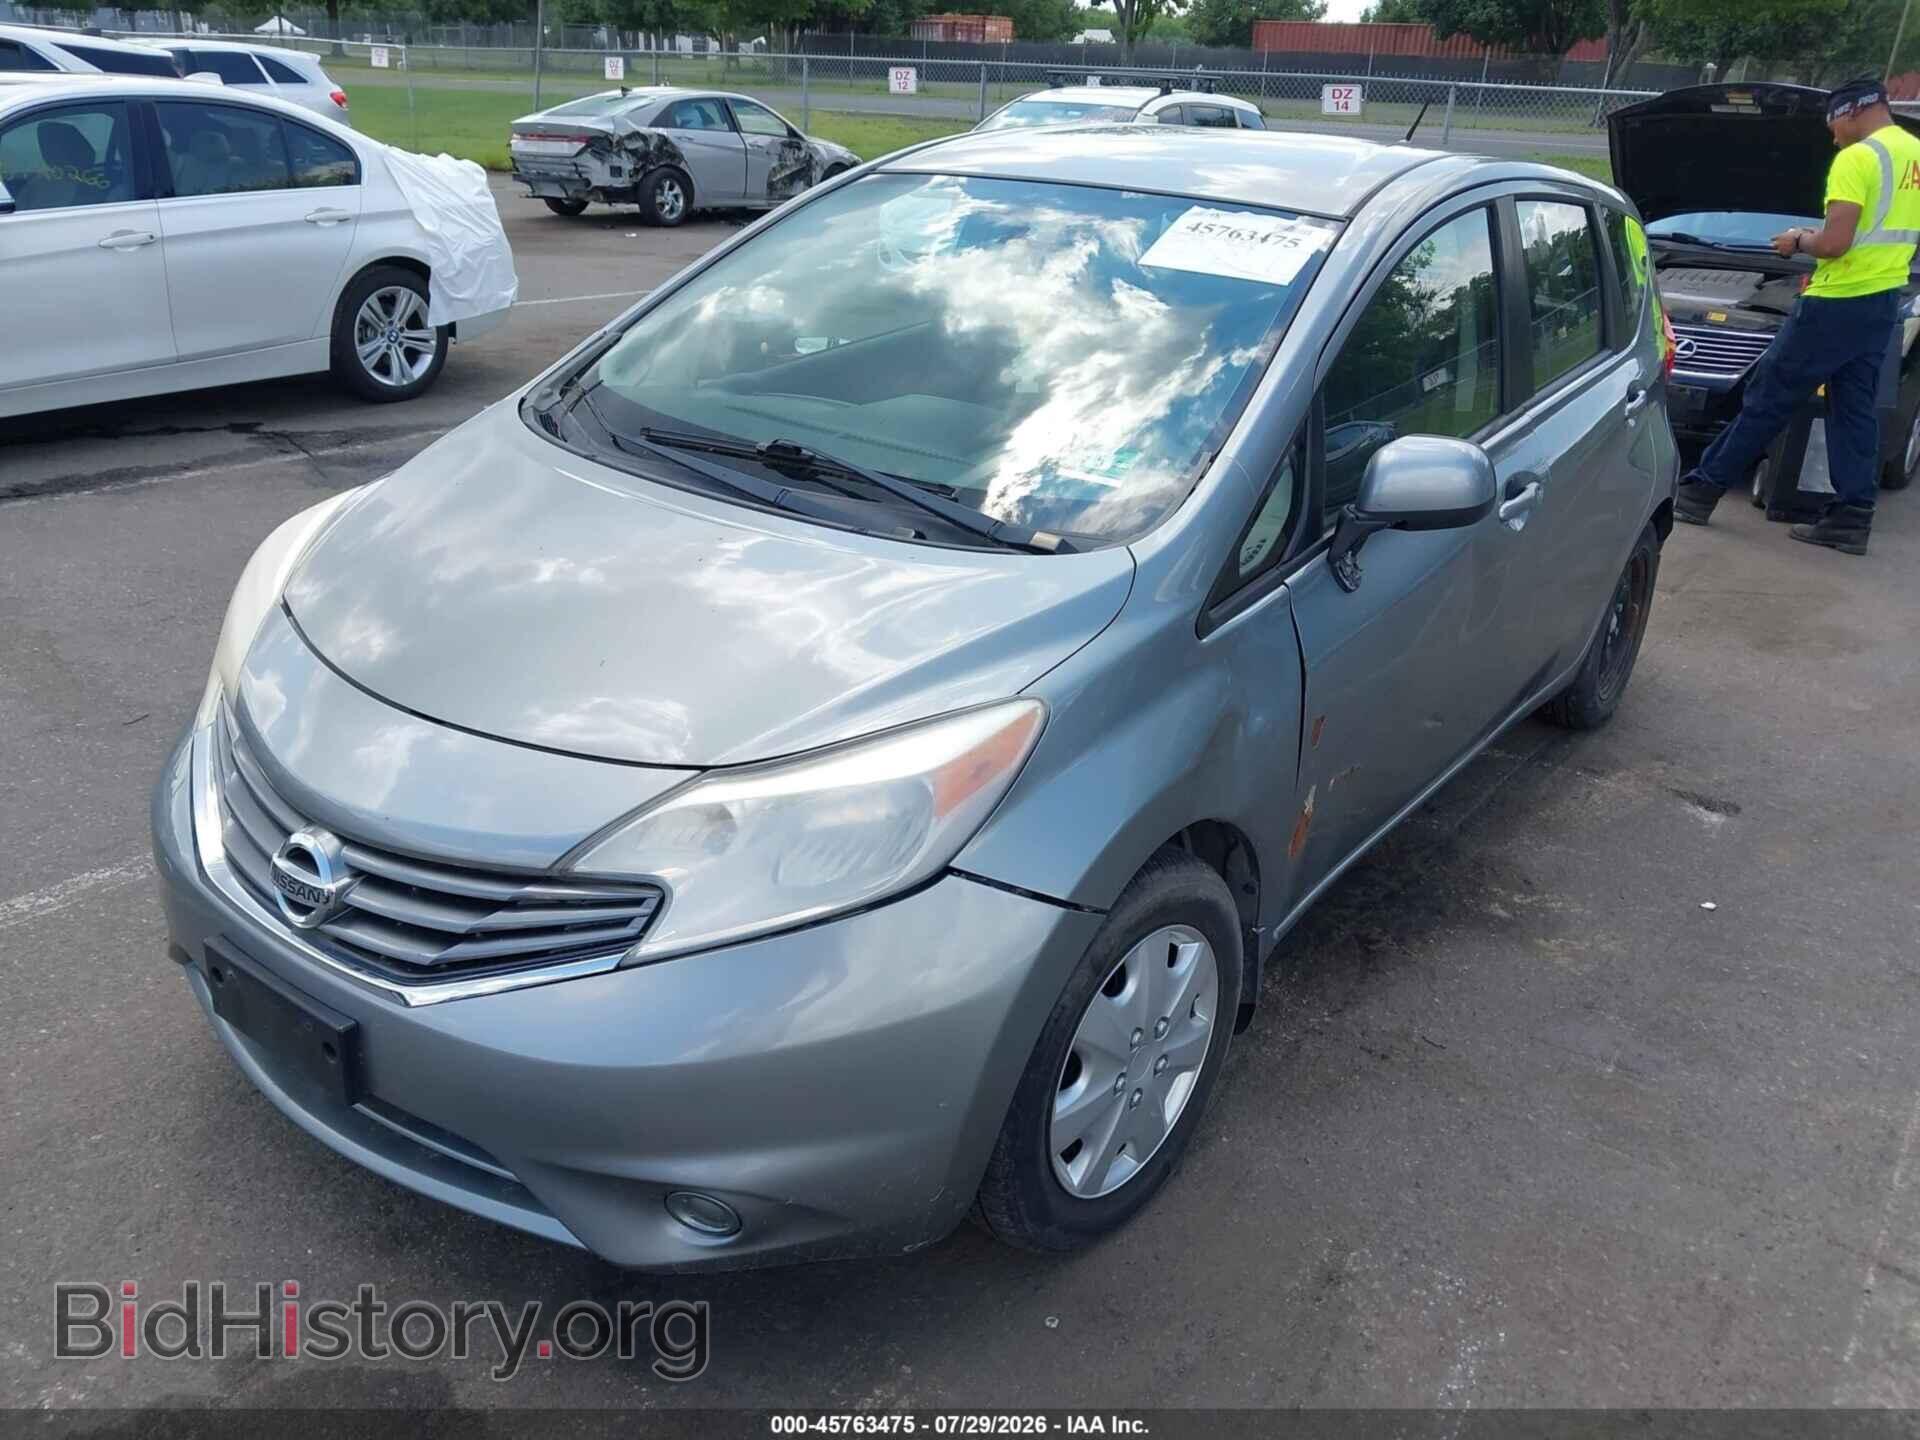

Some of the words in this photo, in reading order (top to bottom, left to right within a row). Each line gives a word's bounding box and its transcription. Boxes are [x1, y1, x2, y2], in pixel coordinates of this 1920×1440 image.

[895, 71, 910, 80] DZ
[897, 81, 908, 90] 12
[1332, 88, 1353, 99] DZ
[1335, 101, 1349, 111] 14
[1186, 221, 1303, 249] 45763475
[272, 868, 322, 905] NISSAN
